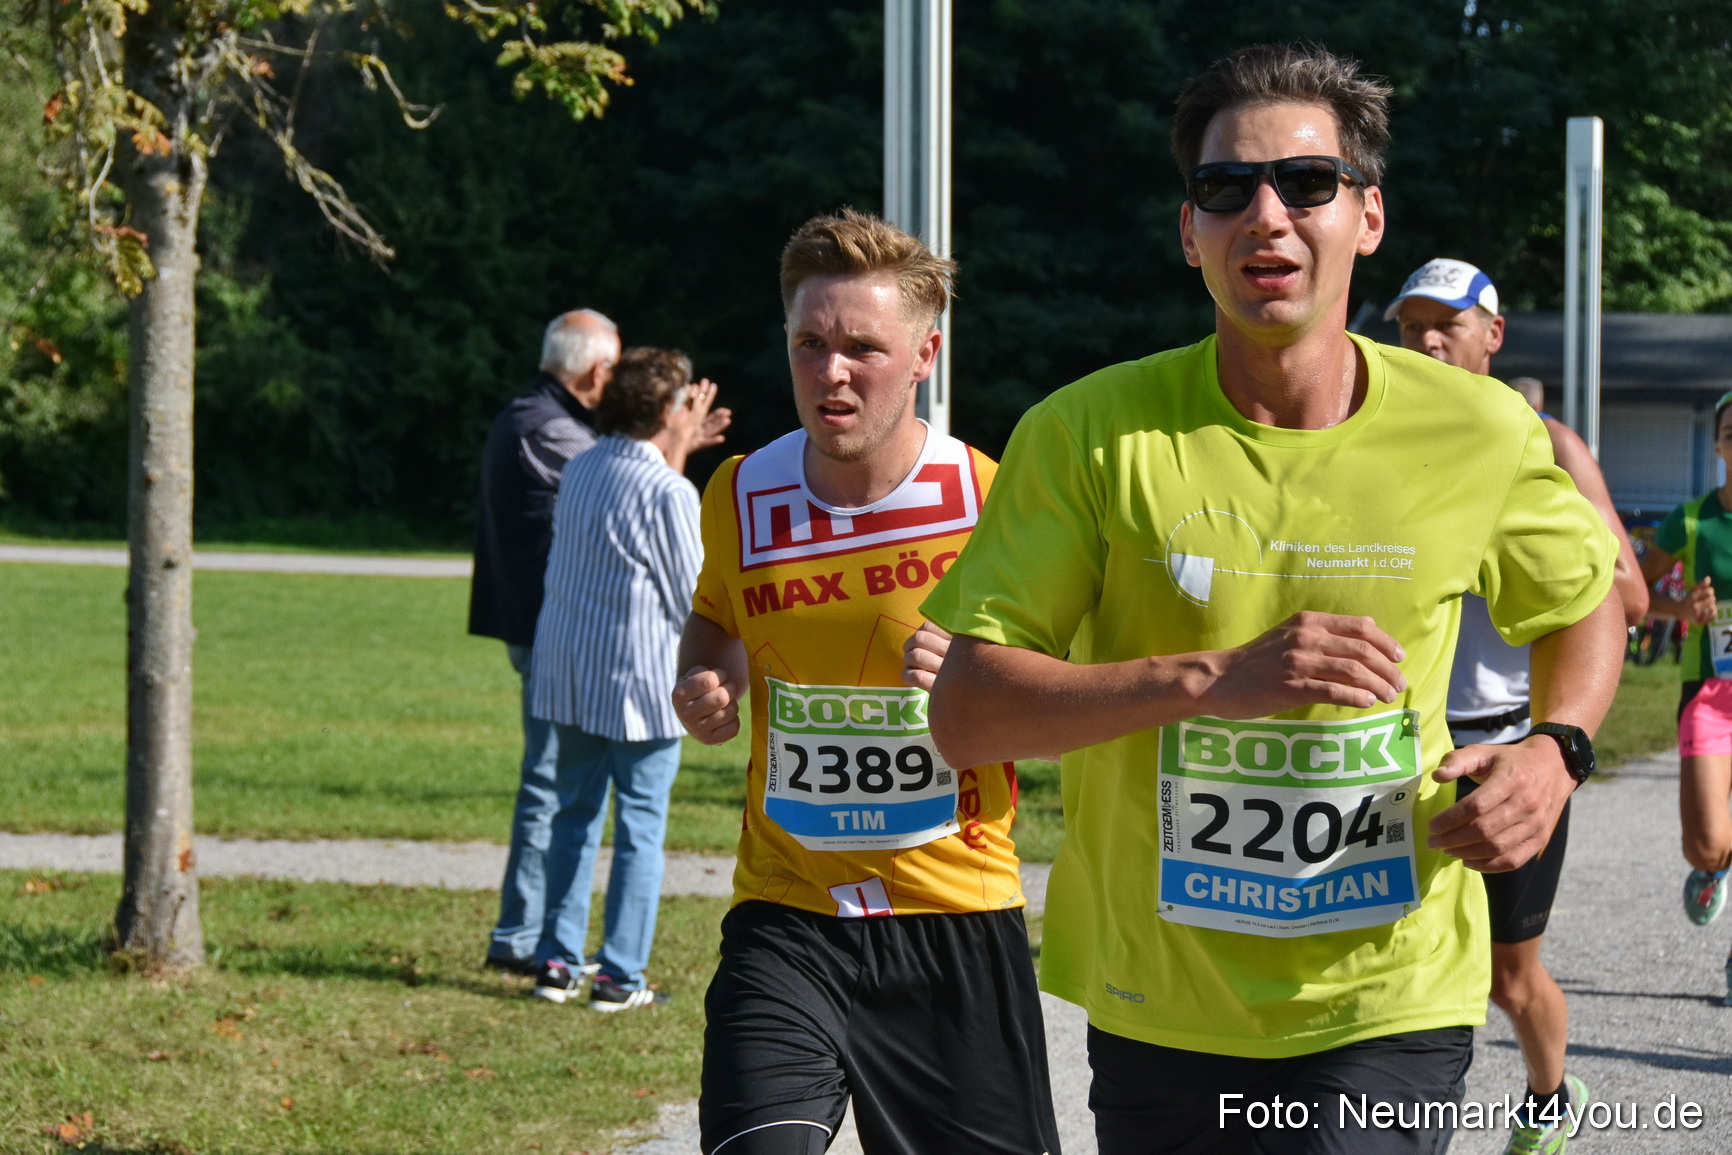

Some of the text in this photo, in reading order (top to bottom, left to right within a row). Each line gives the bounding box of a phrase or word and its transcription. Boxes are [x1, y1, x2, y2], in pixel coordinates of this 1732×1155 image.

[1270, 540, 1416, 555] Kliniken des Landkreises
[1307, 556, 1369, 568] Neumarkt
[742, 571, 851, 618] MAX
[777, 694, 929, 730] BOCK
[783, 743, 934, 795] 2389
[1181, 726, 1397, 779] BOCK
[1394, 792, 1406, 801] D
[831, 810, 886, 831] TIM
[1189, 793, 1385, 864] 2204
[1184, 870, 1390, 914] CHRISTIAN
[1105, 982, 1145, 1004] SPIRO
